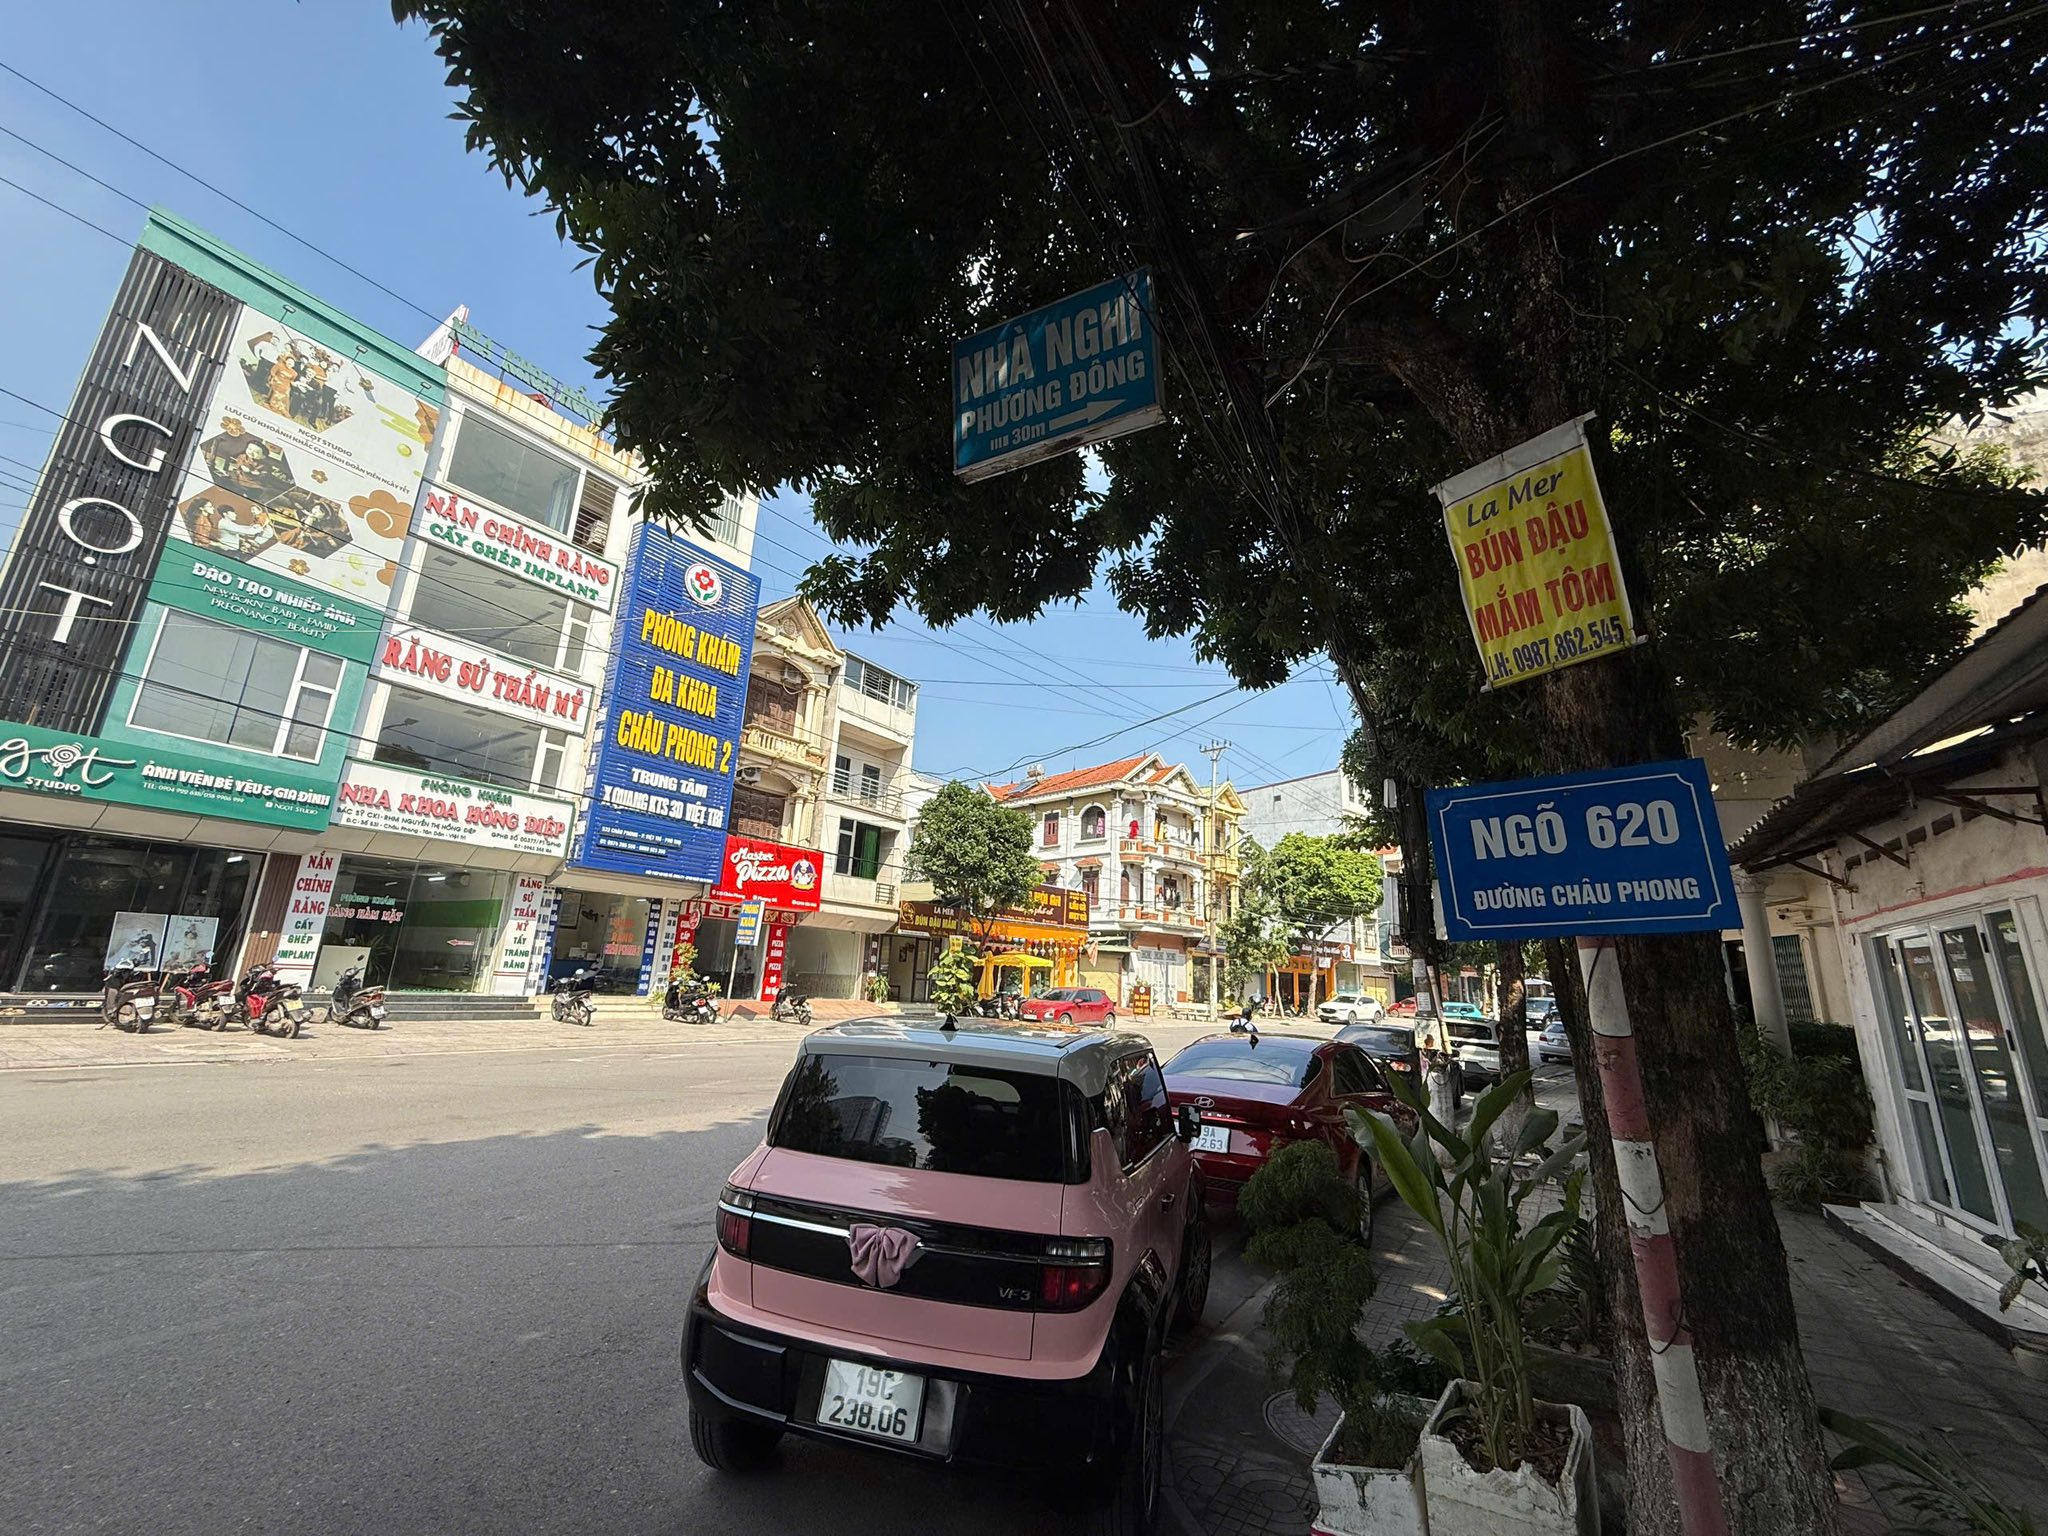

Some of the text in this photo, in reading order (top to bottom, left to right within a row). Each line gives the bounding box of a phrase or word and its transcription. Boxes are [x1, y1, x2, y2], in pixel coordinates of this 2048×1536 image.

[958, 274, 1142, 404] NHÀ NGHỈ
[961, 350, 1146, 440] PHƯƠNG ĐÔNG
[321, 438, 352, 456] STUDIO
[1012, 422, 1046, 446] 30m
[314, 446, 326, 456] GIA
[39, 321, 204, 645] NGỌT
[1467, 470, 1564, 528] La Mer
[424, 492, 610, 585] NẮN CHỈNH RĂNG
[1464, 499, 1590, 580] BÚN ĐẬU
[430, 523, 599, 601] CẤY GHÉP IMPLANT
[203, 584, 339, 632] NEWBORN BABY FAMILY
[237, 576, 272, 598] TẠO
[274, 591, 322, 614] NHIẾP
[324, 604, 357, 626] ẢNH
[1474, 562, 1617, 644] MẮM TÔM
[210, 598, 328, 640] PREGNANCY BEAUTY
[641, 608, 742, 676] PHÒNG KHÁM
[1490, 615, 1626, 681] LH: 0987.862.545
[382, 636, 584, 720] RĂNG SỨ THẨM MỸ
[650, 665, 718, 718] ĐA KHOA
[618, 710, 732, 773] CHÂU PHONG 2
[24, 776, 81, 792] STUDIO
[142, 760, 178, 780] ẢNH
[178, 770, 214, 788] VIỆN
[214, 776, 233, 790] BÉ
[235, 779, 263, 796] YÊU
[262, 786, 274, 796] &
[274, 787, 298, 802] GIA
[298, 788, 331, 806] ĐÌNH
[421, 778, 512, 806] PHÒNG KHÁM
[632, 768, 708, 798] TRUNG TÂM
[296, 806, 318, 816] STUDIO
[340, 783, 566, 841] NHA KHOA HỒNG ĐIỆP
[602, 784, 724, 828] X QUANG KTS 3D VIỆT TRÌ
[1470, 800, 1680, 860] NGÕ 620
[308, 850, 333, 870] NẮN
[730, 848, 774, 863] Master
[296, 874, 333, 894] CHỈNH
[520, 877, 542, 889] RĂNG
[736, 861, 790, 890] Pizza
[292, 896, 326, 914] RĂNG
[522, 892, 534, 903] SỨ
[1474, 877, 1700, 911] ĐƯỜNG CHÂU PHONG
[294, 918, 314, 930] CẤY
[328, 904, 404, 924] RĂNG HÀM MẶT
[514, 904, 536, 918] THẨM
[914, 914, 928, 926] BÚN
[929, 916, 942, 929] ĐẬU
[934, 906, 954, 916] LA MER
[288, 934, 313, 944] GHÉP
[278, 950, 316, 960] IMPLANT
[503, 960, 526, 969] RĂNG
[1203, 1127, 1216, 1138] 9A
[856, 1367, 894, 1400] 19C
[828, 1396, 908, 1436] 238.06
